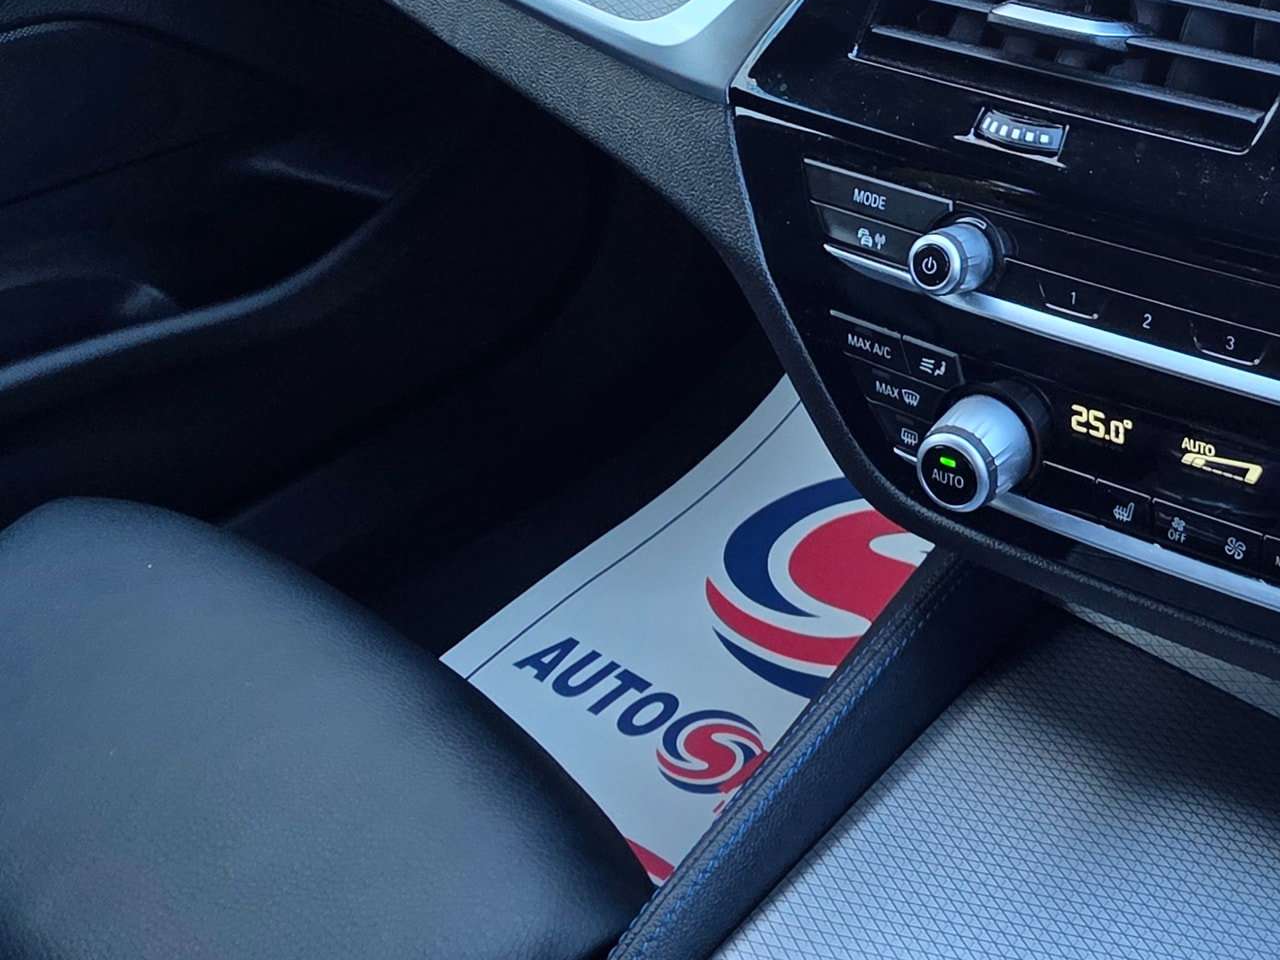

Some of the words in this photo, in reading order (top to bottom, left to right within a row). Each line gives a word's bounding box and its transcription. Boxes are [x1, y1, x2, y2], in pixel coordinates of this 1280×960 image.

[853, 189, 886, 210] MODE
[1142, 313, 1152, 329] 2
[848, 333, 871, 351] MAX
[873, 344, 892, 359] A/C
[1225, 336, 1235, 350] 3
[875, 381, 899, 400] MAX
[1181, 437, 1216, 456] AUTO
[931, 468, 965, 489] AUTO
[1167, 528, 1187, 544] OFF
[512, 636, 680, 737] AUTO
